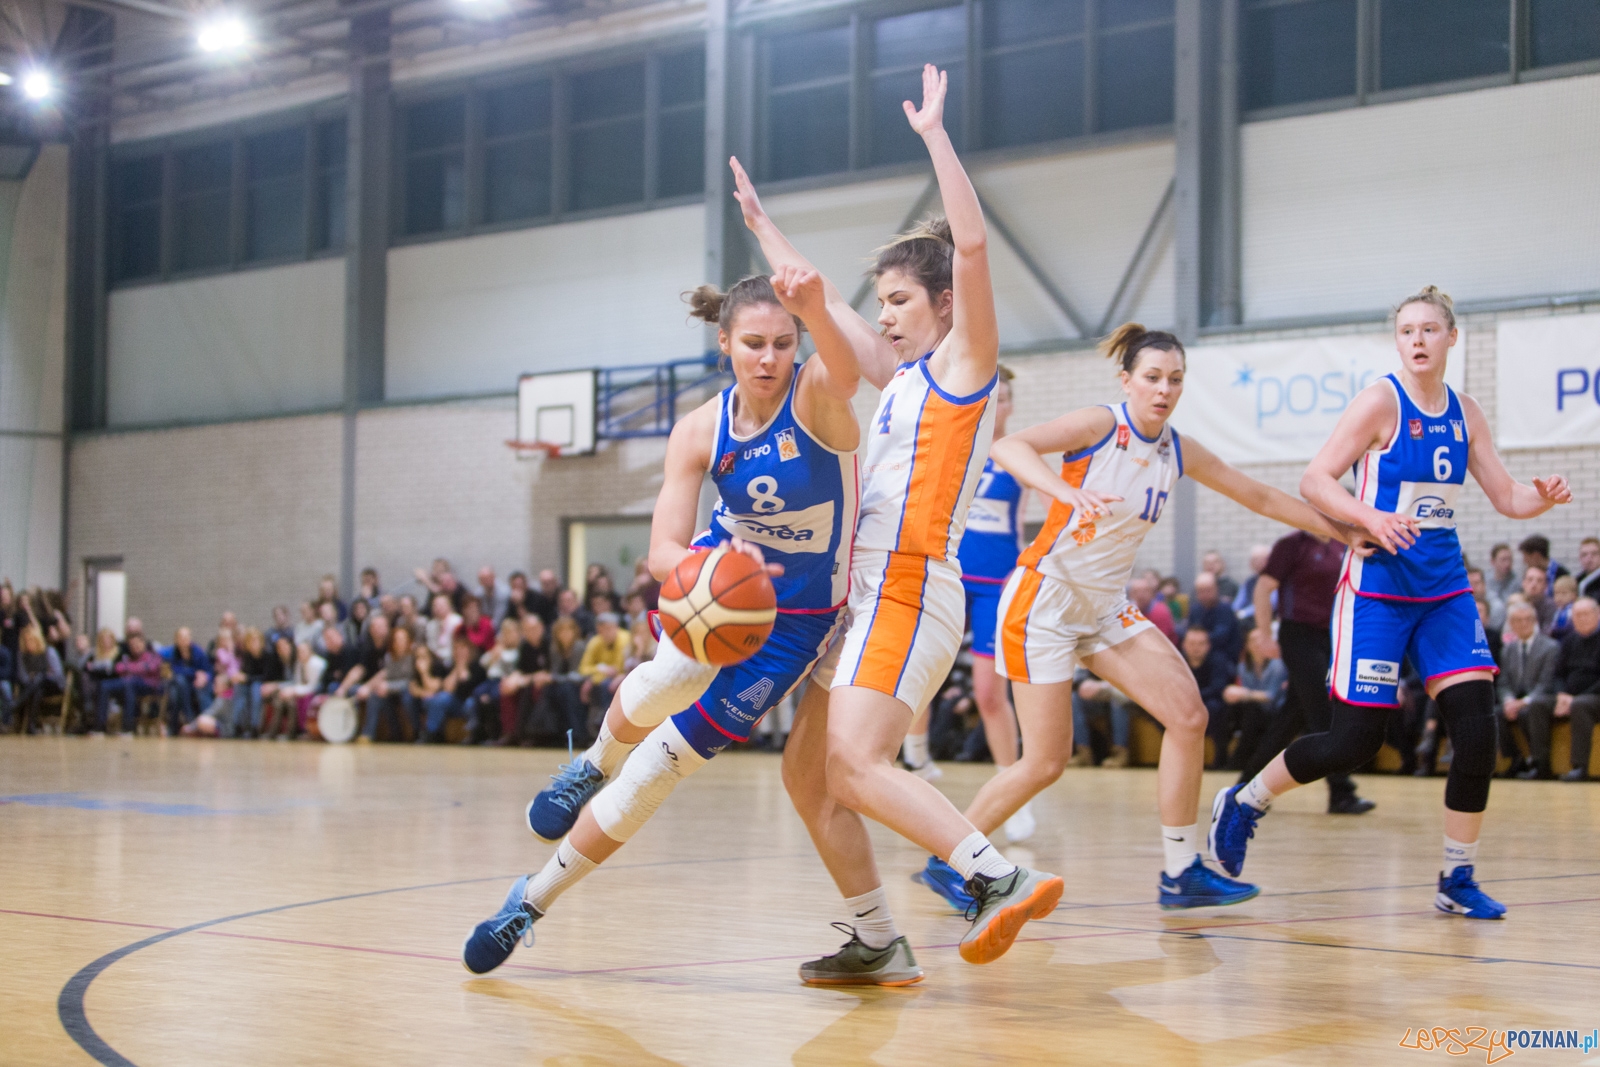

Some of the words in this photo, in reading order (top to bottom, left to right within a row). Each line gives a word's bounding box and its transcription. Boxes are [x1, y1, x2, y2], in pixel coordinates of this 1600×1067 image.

[877, 392, 897, 435] 4
[1433, 445, 1453, 481] 6
[746, 475, 786, 513] 8
[1138, 487, 1168, 523] 10
[1416, 503, 1455, 519] Enea
